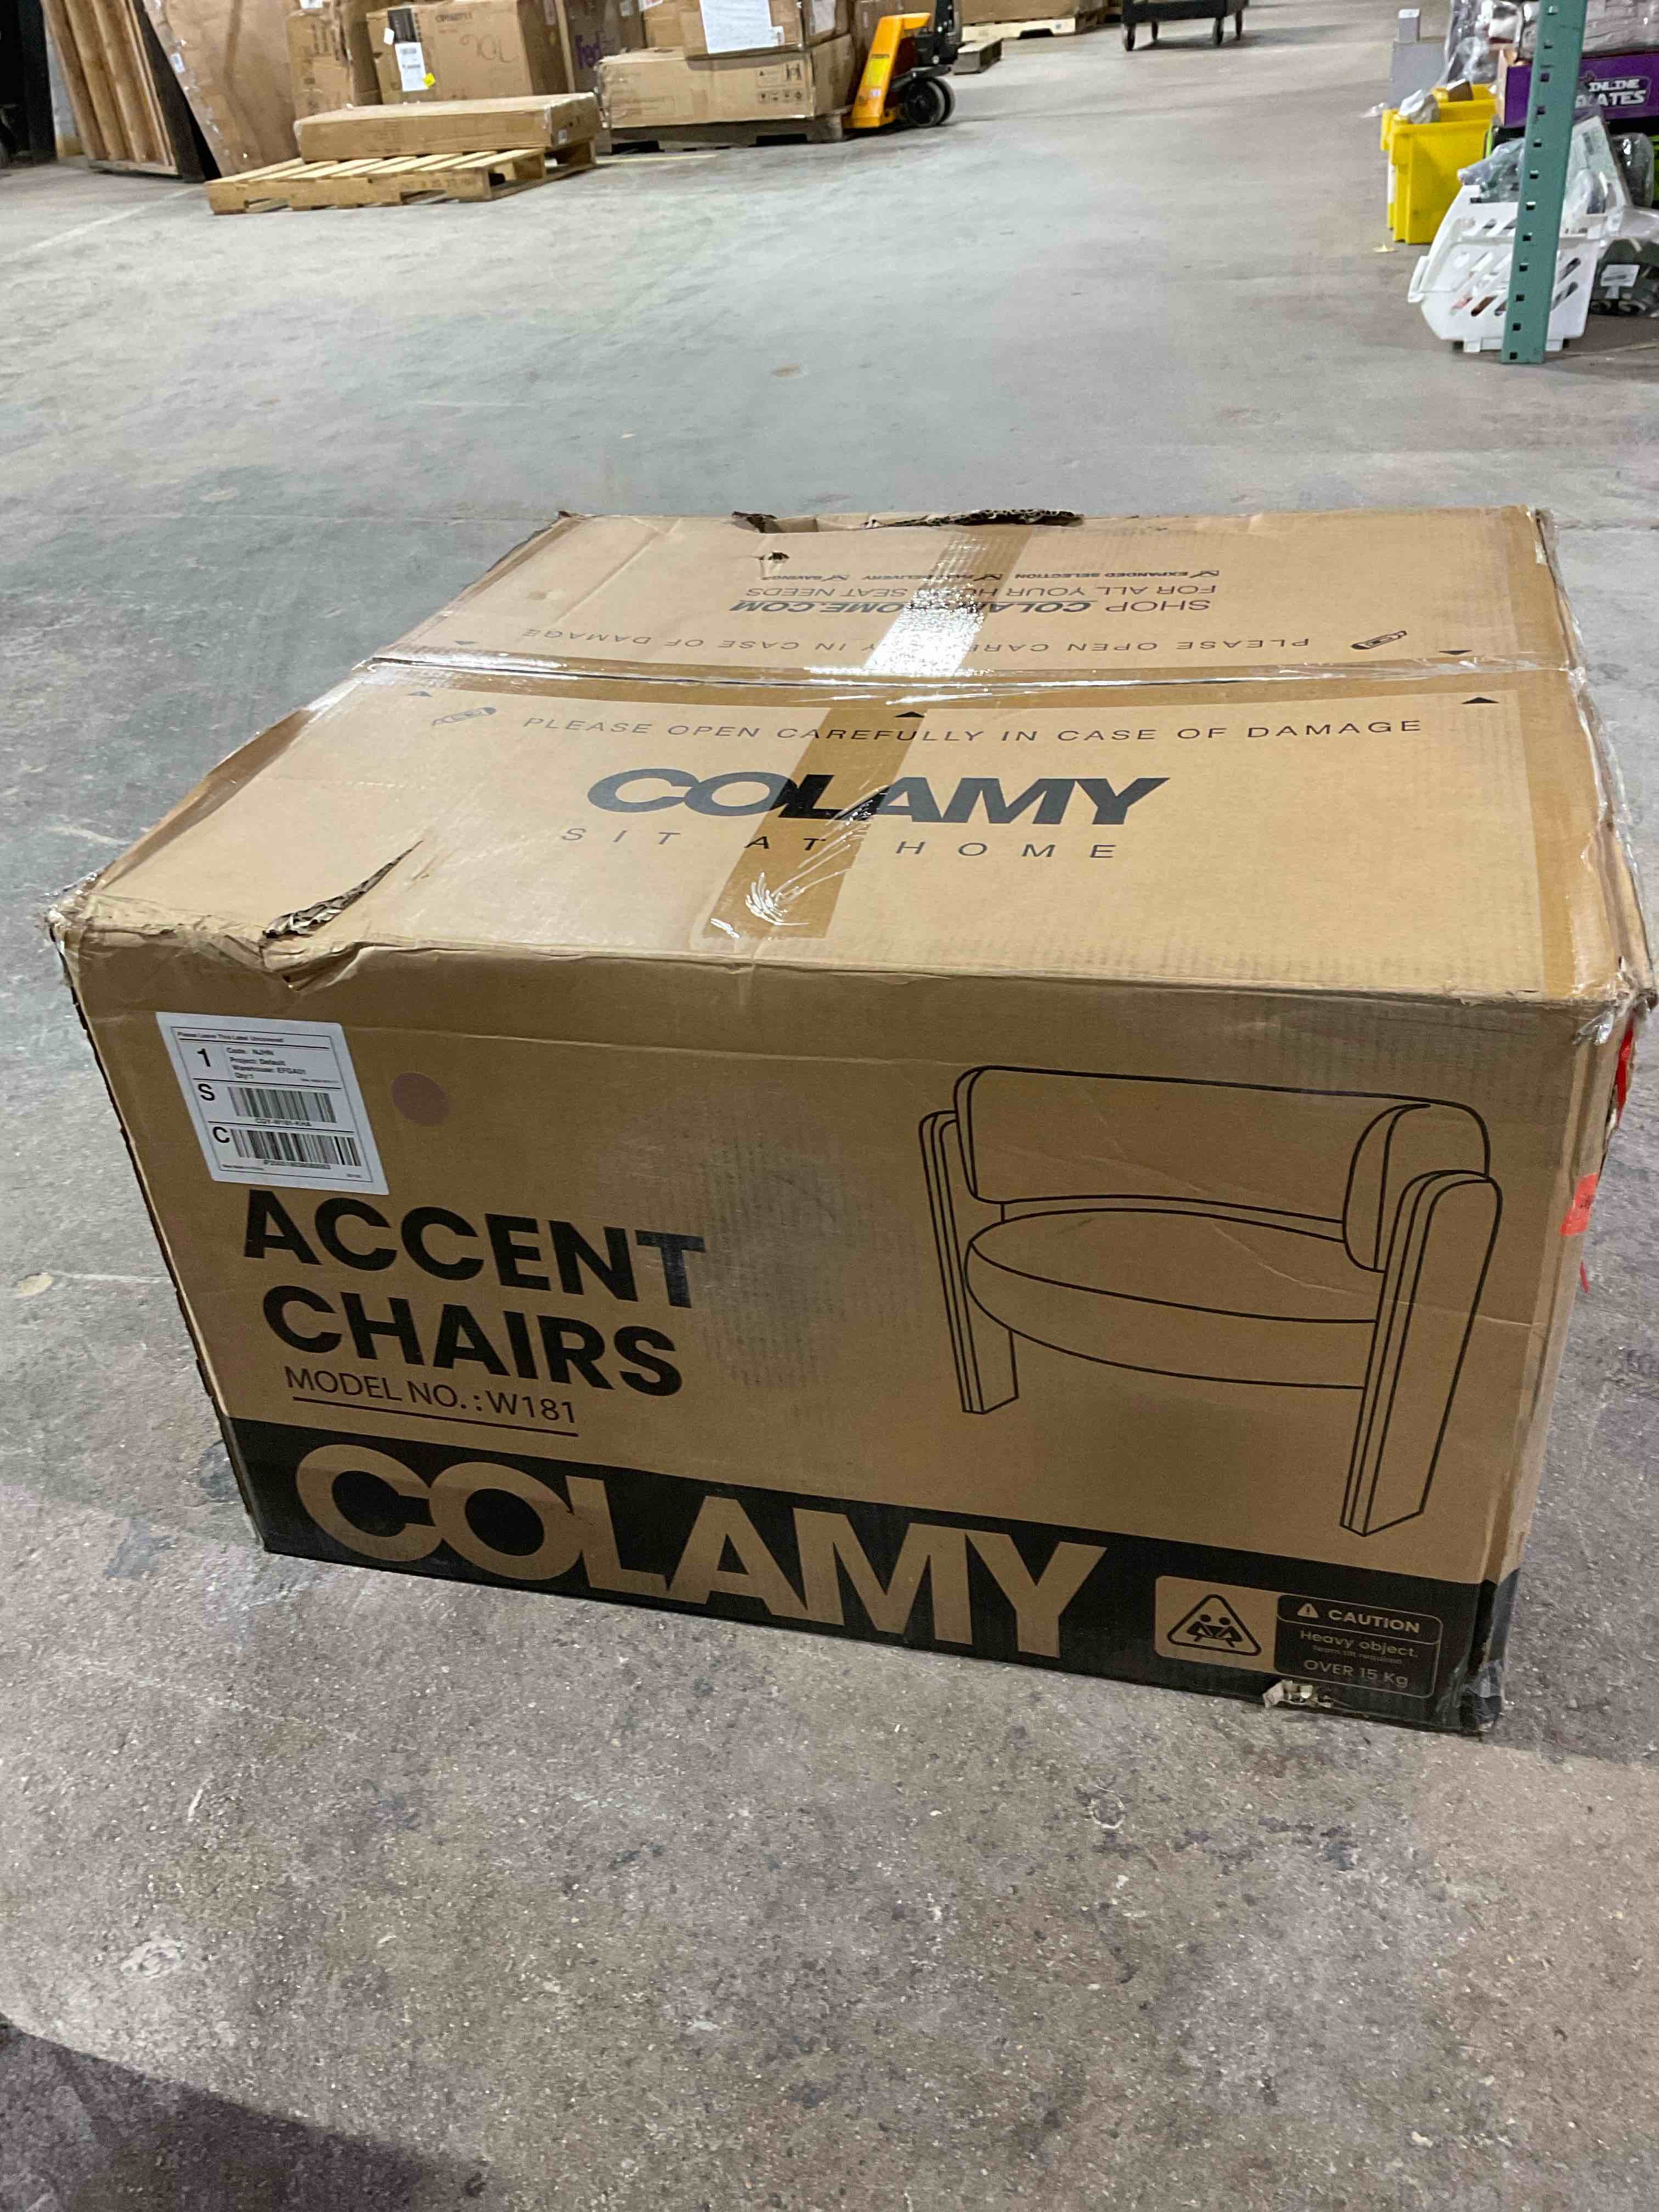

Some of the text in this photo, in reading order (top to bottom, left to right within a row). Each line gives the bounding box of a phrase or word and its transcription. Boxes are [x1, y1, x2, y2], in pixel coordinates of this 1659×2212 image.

[746, 588, 836, 596] NEEDS
[840, 588, 909, 597] SEAT
[1006, 587, 1085, 596] YOUR
[1097, 586, 1149, 595] ALL
[1156, 585, 1217, 595] FOR
[729, 600, 1211, 613] SHOP COLAOME.COM
[521, 628, 652, 644] DAMAGE
[665, 639, 703, 648] OF
[1176, 638, 1310, 650] PLEASE
[718, 640, 799, 650] CASE
[1067, 641, 1158, 651] OPEN
[523, 717, 1423, 742] PLEASE OPEN CAREFULLY IN CASE OF DAMAGE
[588, 768, 1170, 825] COLAMY
[561, 827, 1117, 859] SIT AT HOME
[197, 1048, 211, 1067] 1
[198, 1083, 216, 1101] S
[212, 1126, 230, 1143] C
[244, 1189, 707, 1309] ACCENT
[262, 1285, 682, 1397] CHAIRS
[284, 1366, 402, 1401] MODEL
[296, 1444, 1107, 1658] COLAMY
[1328, 1609, 1420, 1634] CAUTION
[1299, 1630, 1355, 1650] Heavy
[1303, 1660, 1409, 1689] OVER 15 Kg
